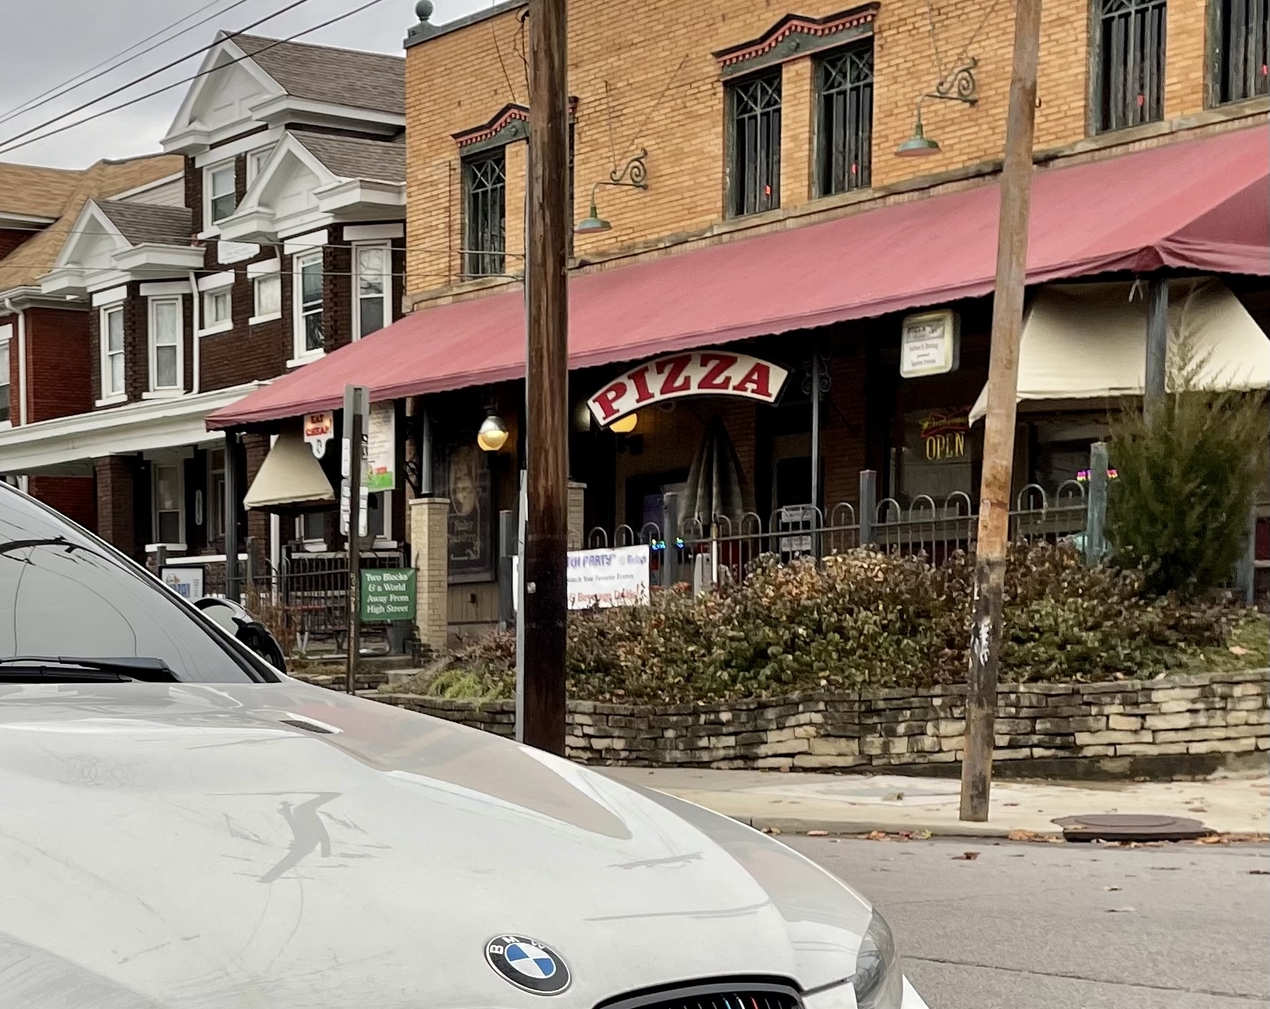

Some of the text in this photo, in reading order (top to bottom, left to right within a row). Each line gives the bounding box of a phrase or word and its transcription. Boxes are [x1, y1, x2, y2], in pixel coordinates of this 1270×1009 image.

[592, 354, 772, 420] PIZZA
[310, 413, 324, 424] EAT
[365, 572, 408, 581] Two Blocks
[368, 583, 376, 592] &
[383, 583, 406, 591] World
[367, 593, 409, 604] Away From
[367, 604, 408, 614] High Street
[489, 936, 546, 955] BMW
